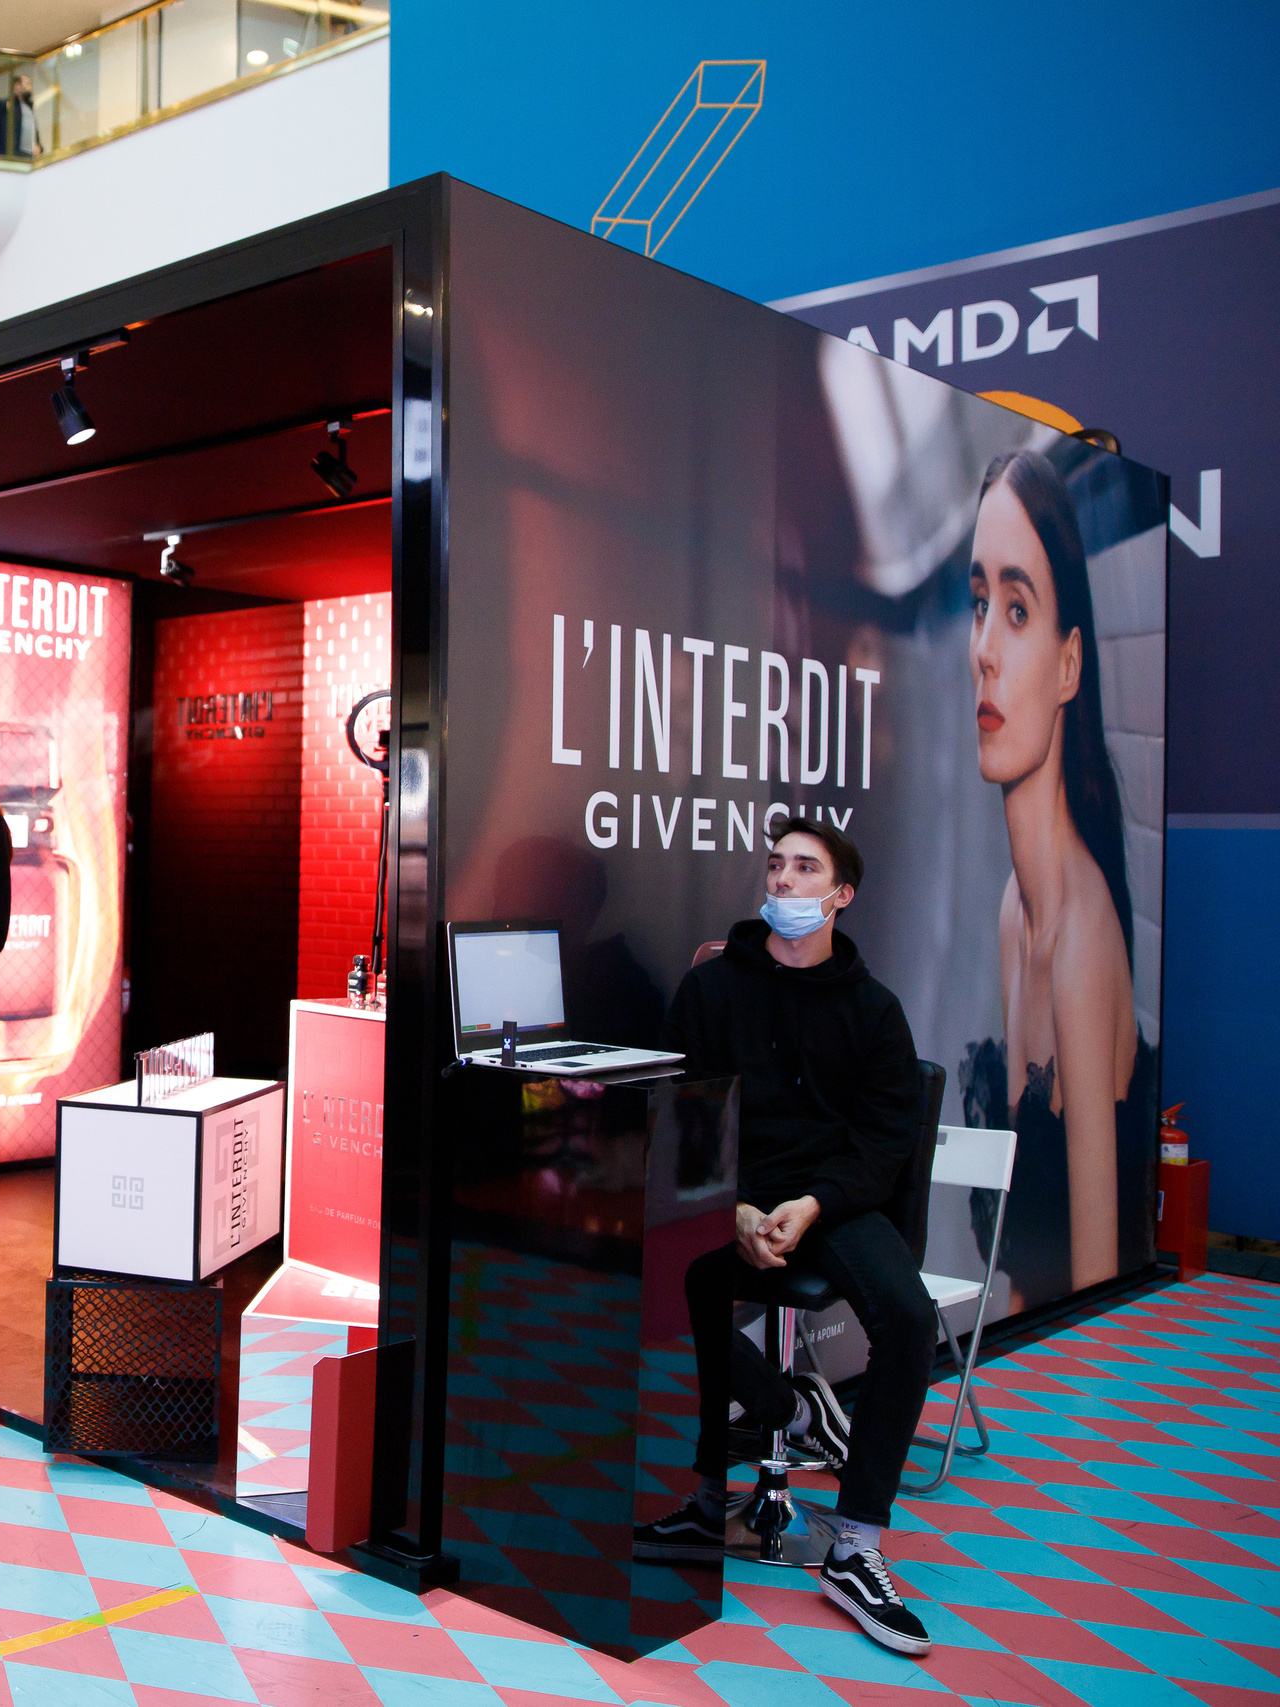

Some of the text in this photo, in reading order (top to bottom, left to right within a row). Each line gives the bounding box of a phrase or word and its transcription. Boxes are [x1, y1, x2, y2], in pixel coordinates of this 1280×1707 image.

[552, 614, 880, 789] L'INTERDIT
[585, 791, 853, 852] GIVENCY
[230, 1118, 244, 1248] L'INTERDIT
[241, 1129, 249, 1228] GIVENCHY
[313, 1132, 384, 1159] GIVENCH
[325, 1207, 335, 1217] DE
[336, 1210, 366, 1225] PARFUM
